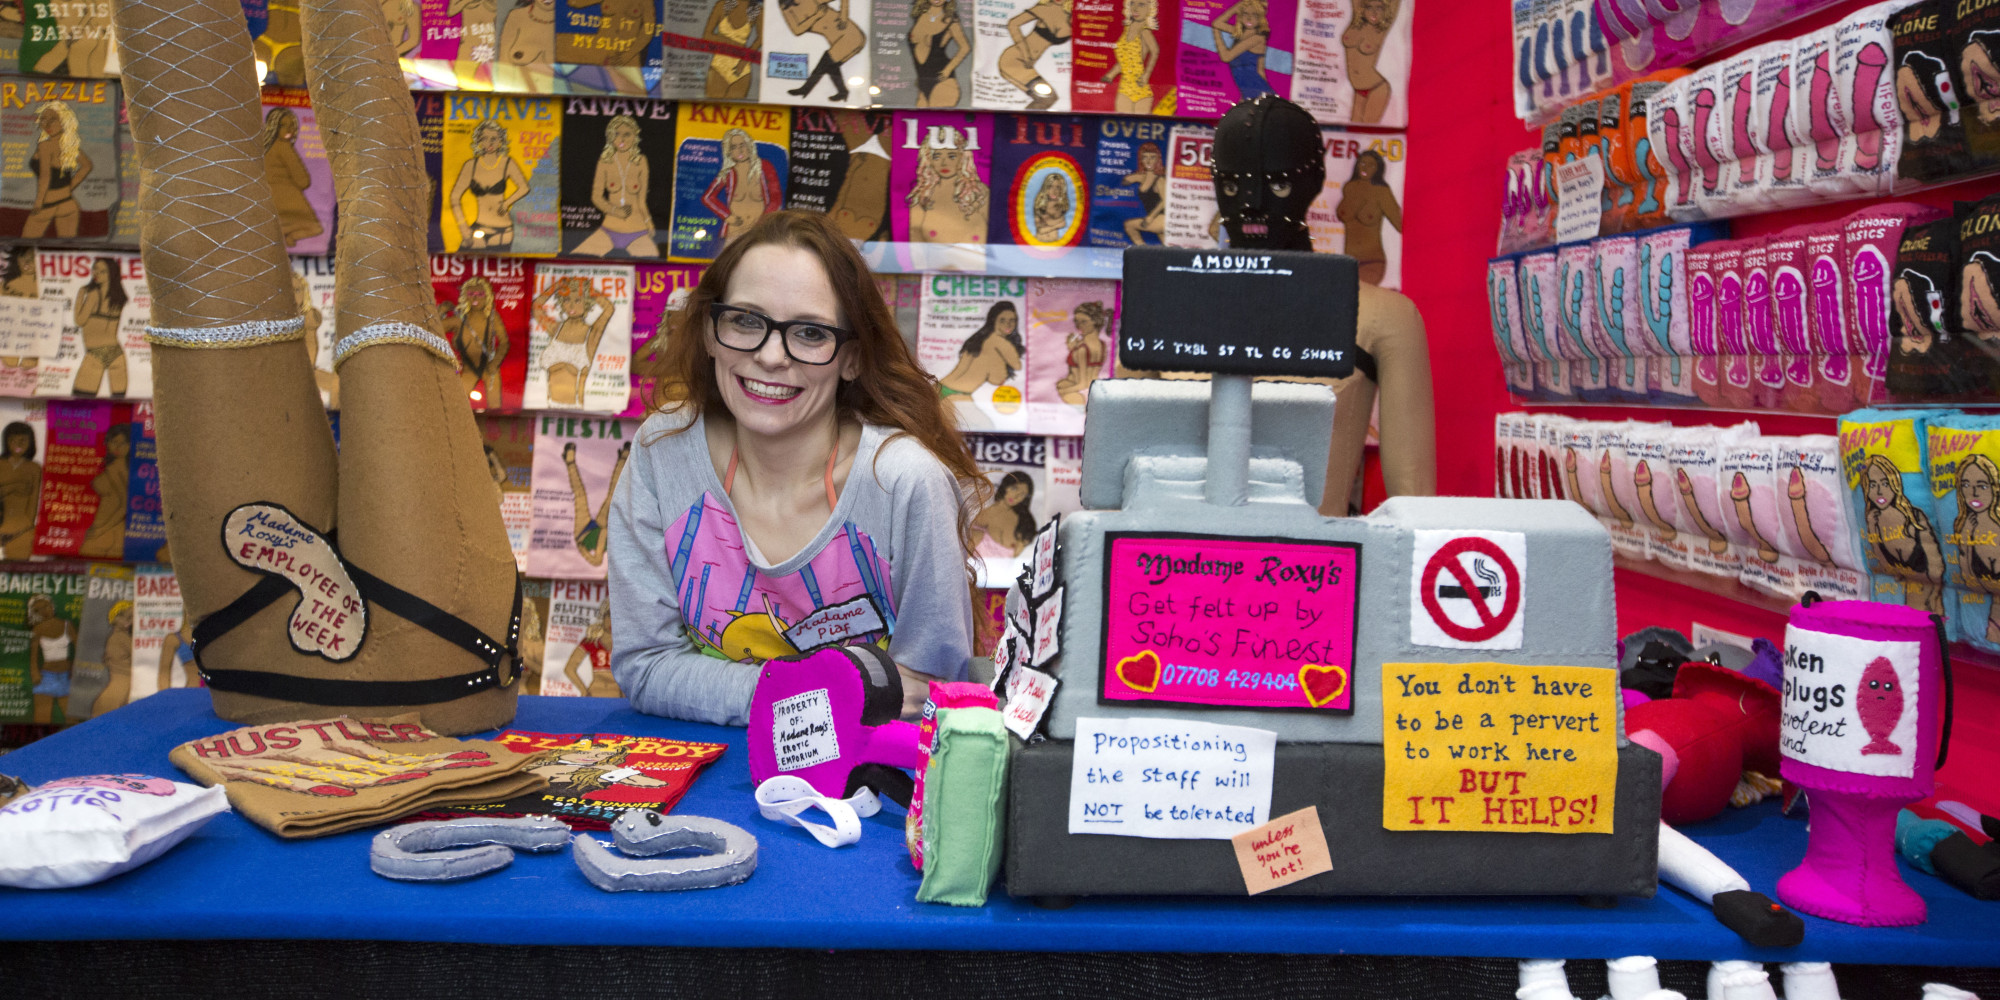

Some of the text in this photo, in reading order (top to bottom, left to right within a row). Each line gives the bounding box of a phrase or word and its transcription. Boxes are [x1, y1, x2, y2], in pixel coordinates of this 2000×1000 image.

[1, 81, 108, 110] RAZZLE
[449, 96, 552, 121] KNAVE
[566, 98, 672, 121] KNAVE
[688, 105, 783, 131] KNAVE
[901, 118, 981, 150] lui
[1009, 114, 1086, 147] lui
[1101, 120, 1166, 140] OVER
[1191, 254, 1272, 270] AMOUNT
[932, 275, 1026, 297] CHEEKS
[1173, 341, 1208, 355] TXBL
[1218, 344, 1235, 357] ST
[1245, 346, 1263, 359] TL
[1272, 346, 1292, 359] CG
[1300, 349, 1344, 361] SHORT
[541, 416, 623, 440] FIESTA
[239, 523, 298, 549] Roxy's
[247, 511, 314, 544] Madame
[240, 542, 360, 614] EMPLOYEE OF
[1136, 552, 1343, 594] Madame Roxy's
[89, 577, 134, 600] BARE
[313, 599, 348, 629] THE
[551, 615, 591, 627] CELEBS
[796, 606, 866, 636] Madame
[1129, 592, 1323, 630] Get felt up by
[139, 619, 177, 630] LOVE
[292, 613, 345, 651] WEEK
[1232, 628, 1334, 665] Finest
[1163, 663, 1299, 691] 07708 429404
[1397, 673, 1594, 698] You don't have
[1783, 677, 1846, 712] plugs
[780, 728, 809, 742] Madame
[1396, 710, 1600, 736] to be a pervert
[193, 720, 433, 759] HUSTLER
[499, 735, 724, 758] PLAYBOY
[782, 740, 810, 755] EROTIC
[1405, 741, 1577, 762] to work here
[781, 748, 819, 766] EMPORIUM
[1087, 768, 1124, 784] the
[1216, 770, 1250, 787] will
[1459, 768, 1527, 796] BUT
[542, 794, 661, 808] REAL BUNNIES
[1407, 794, 1598, 827] IT HELPS!
[1084, 803, 1255, 825] NOT be tolerated
[1251, 824, 1295, 852] unless
[1257, 842, 1301, 867] you're
[1270, 859, 1304, 880] hot!
